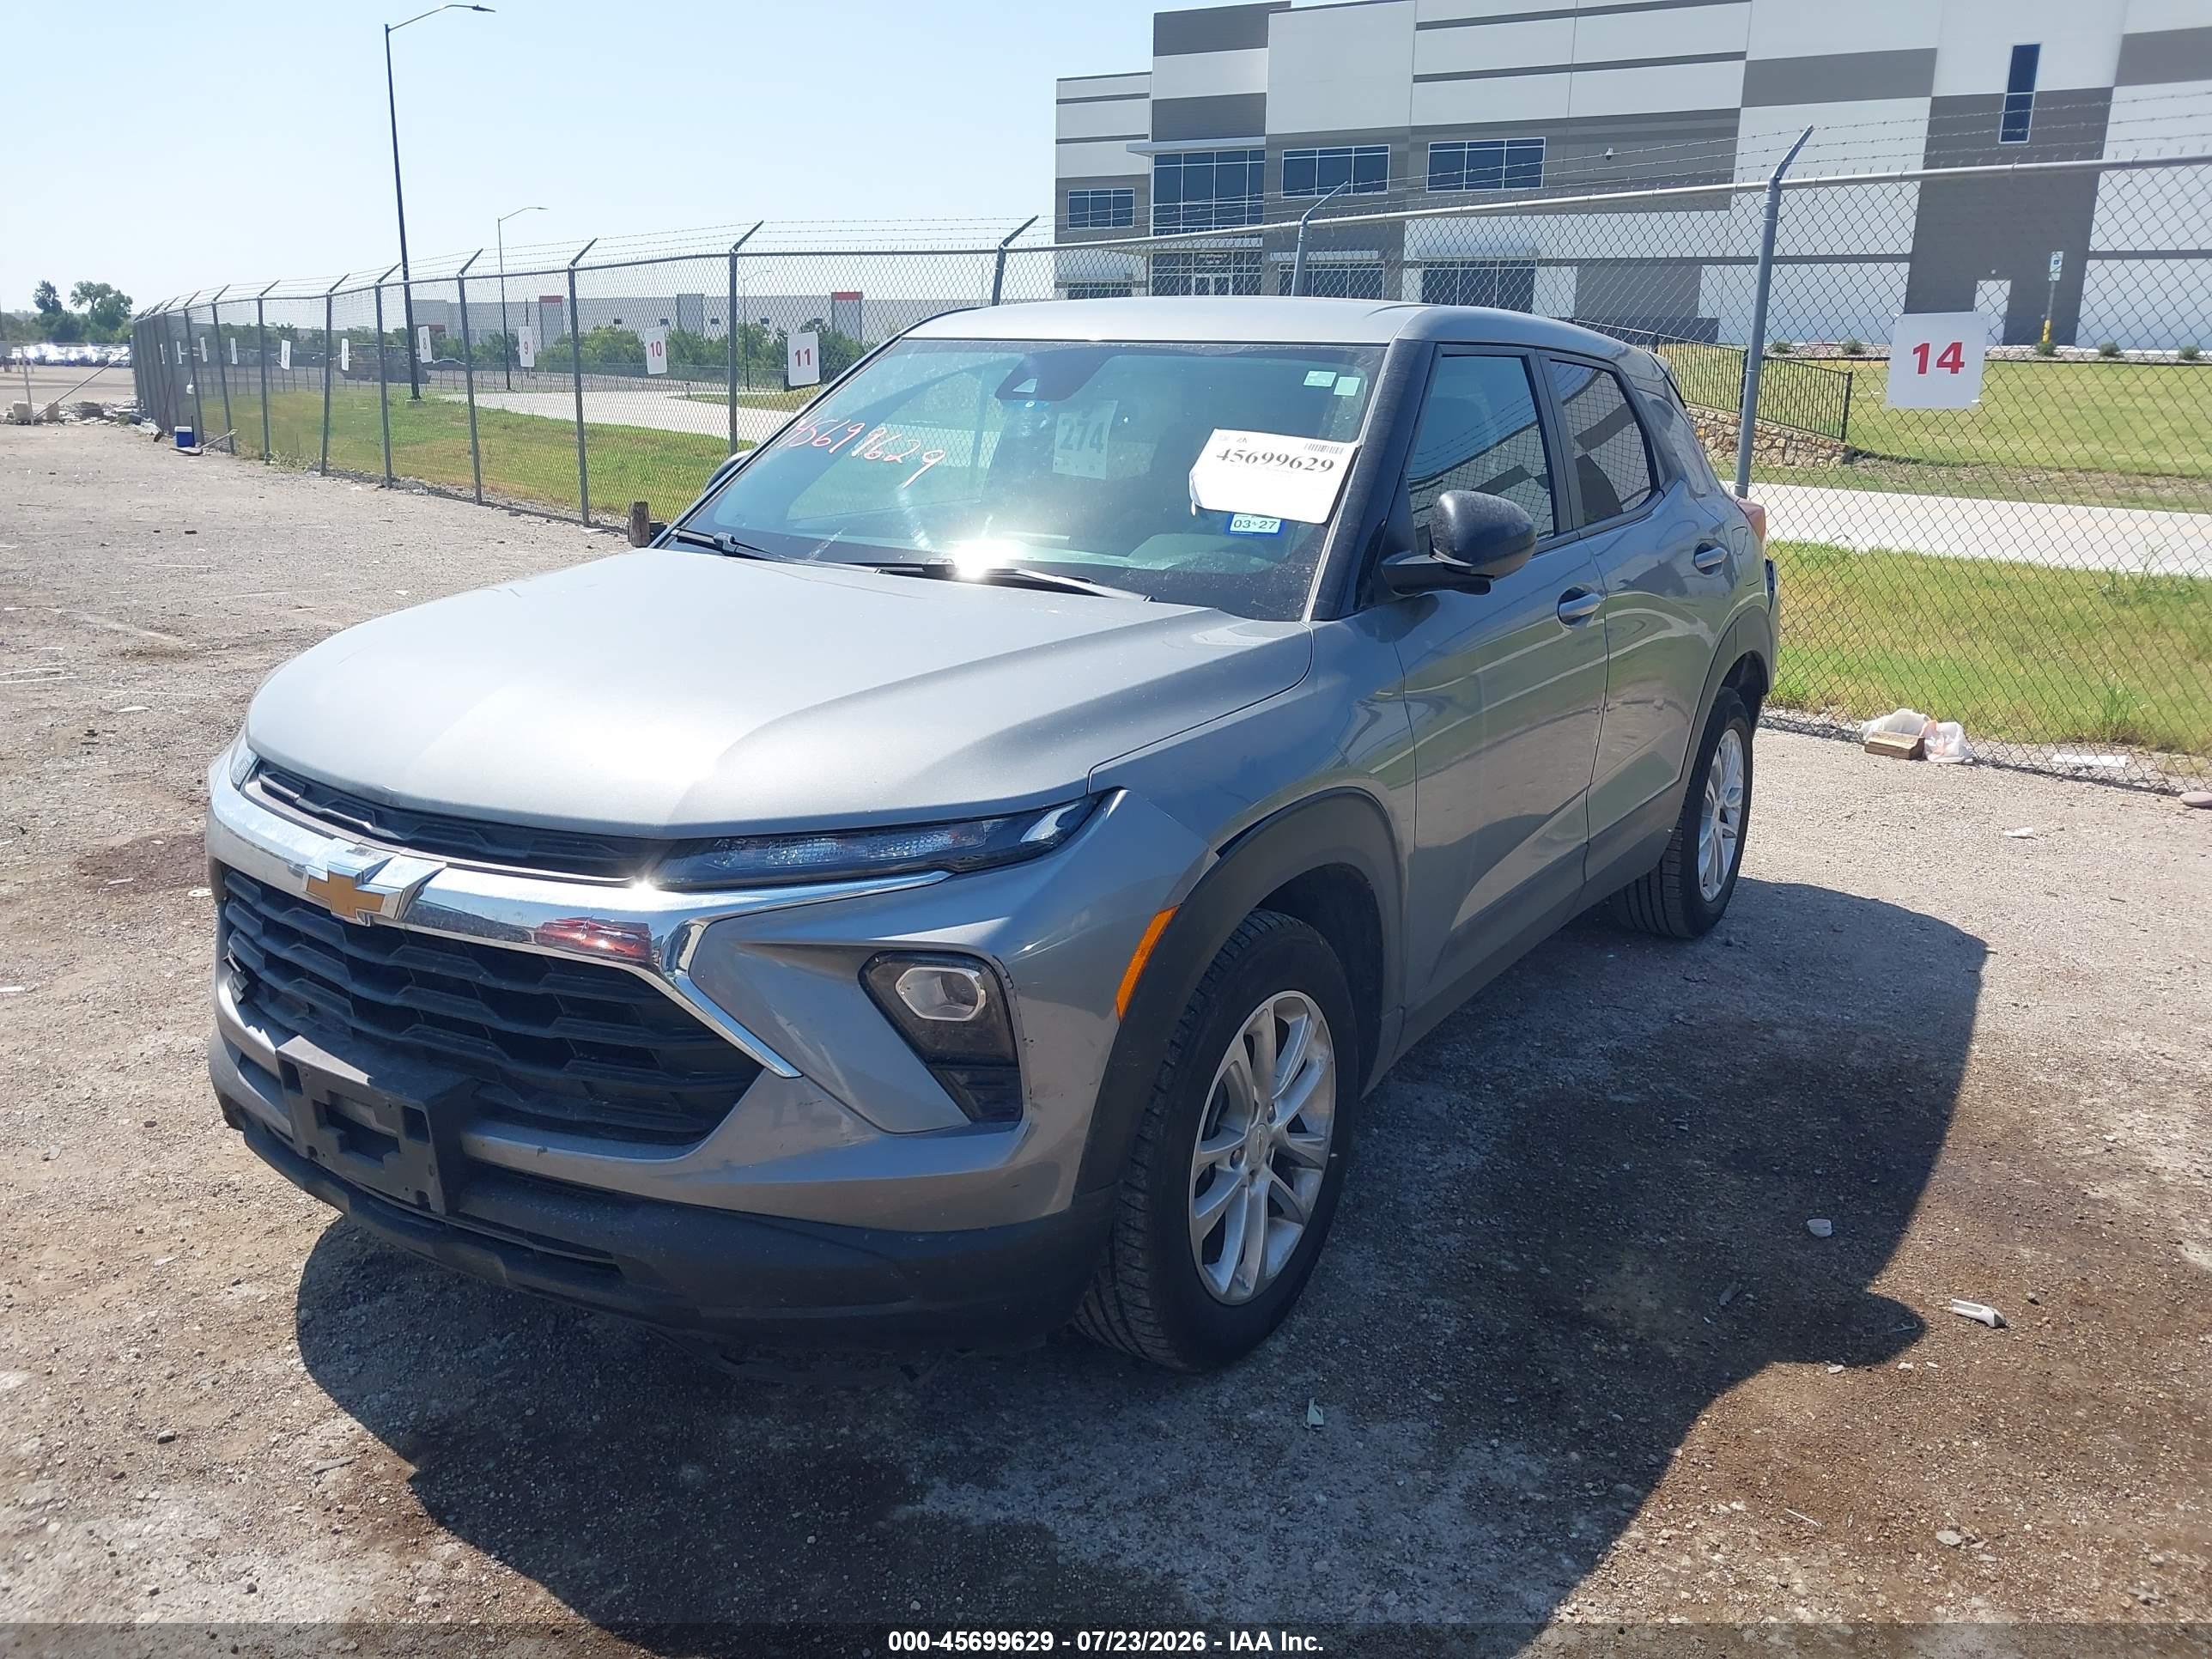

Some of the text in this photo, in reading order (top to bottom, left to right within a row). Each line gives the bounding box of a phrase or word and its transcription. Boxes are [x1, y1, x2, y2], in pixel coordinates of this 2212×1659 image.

[422, 337, 428, 350] 8
[524, 341, 529, 356] 9
[649, 340, 663, 358] 10
[794, 348, 811, 367] 11
[1912, 342, 1966, 375] 14
[1059, 418, 1105, 453] 274
[1216, 448, 1334, 473] 45699629
[1233, 520, 1278, 529] 03 27
